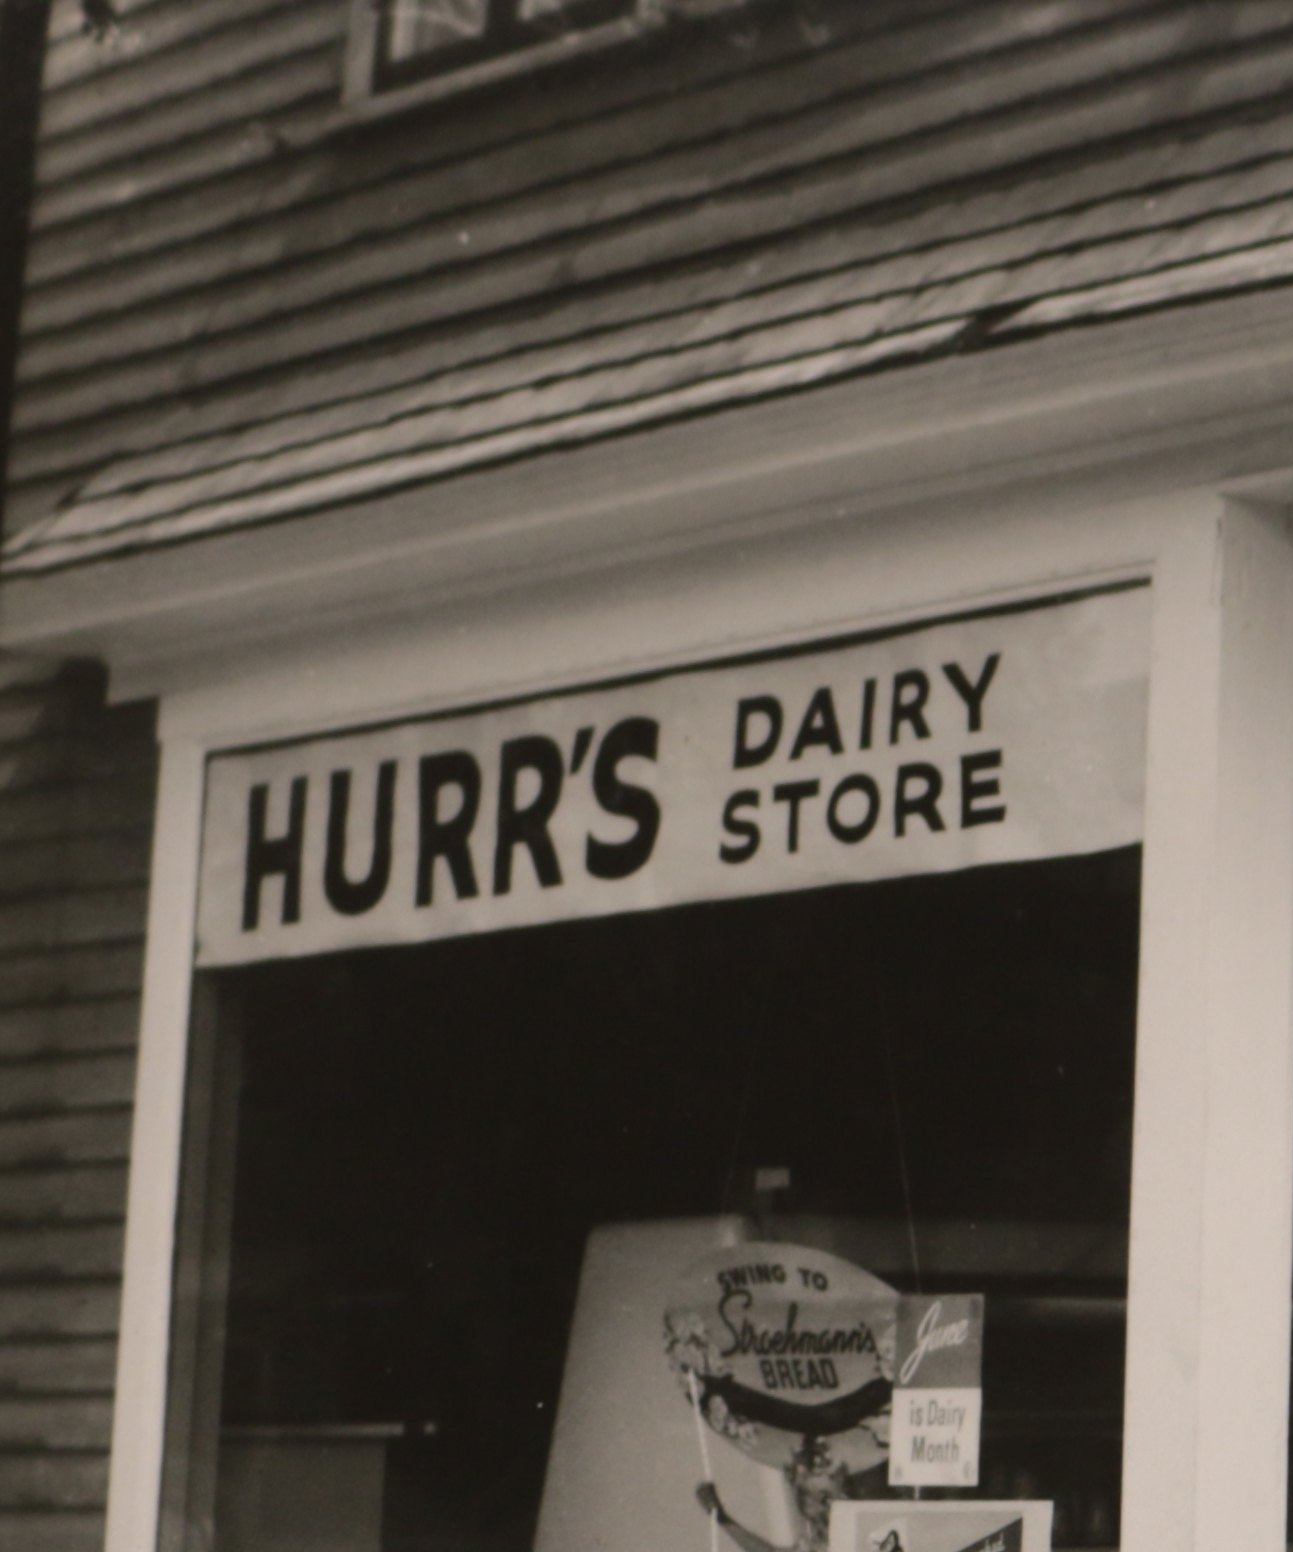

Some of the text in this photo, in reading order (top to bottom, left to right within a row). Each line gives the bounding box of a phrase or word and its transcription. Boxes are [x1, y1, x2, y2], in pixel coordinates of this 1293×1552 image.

[731, 652, 1001, 770] DAIRY
[240, 716, 662, 933] HURR'S
[717, 749, 1007, 865] STORE
[716, 1263, 829, 1292] SWING TO
[901, 1300, 970, 1385] June
[759, 1358, 840, 1390] BREAD
[909, 1400, 966, 1431] is Dairy
[911, 1435, 960, 1464] Month
